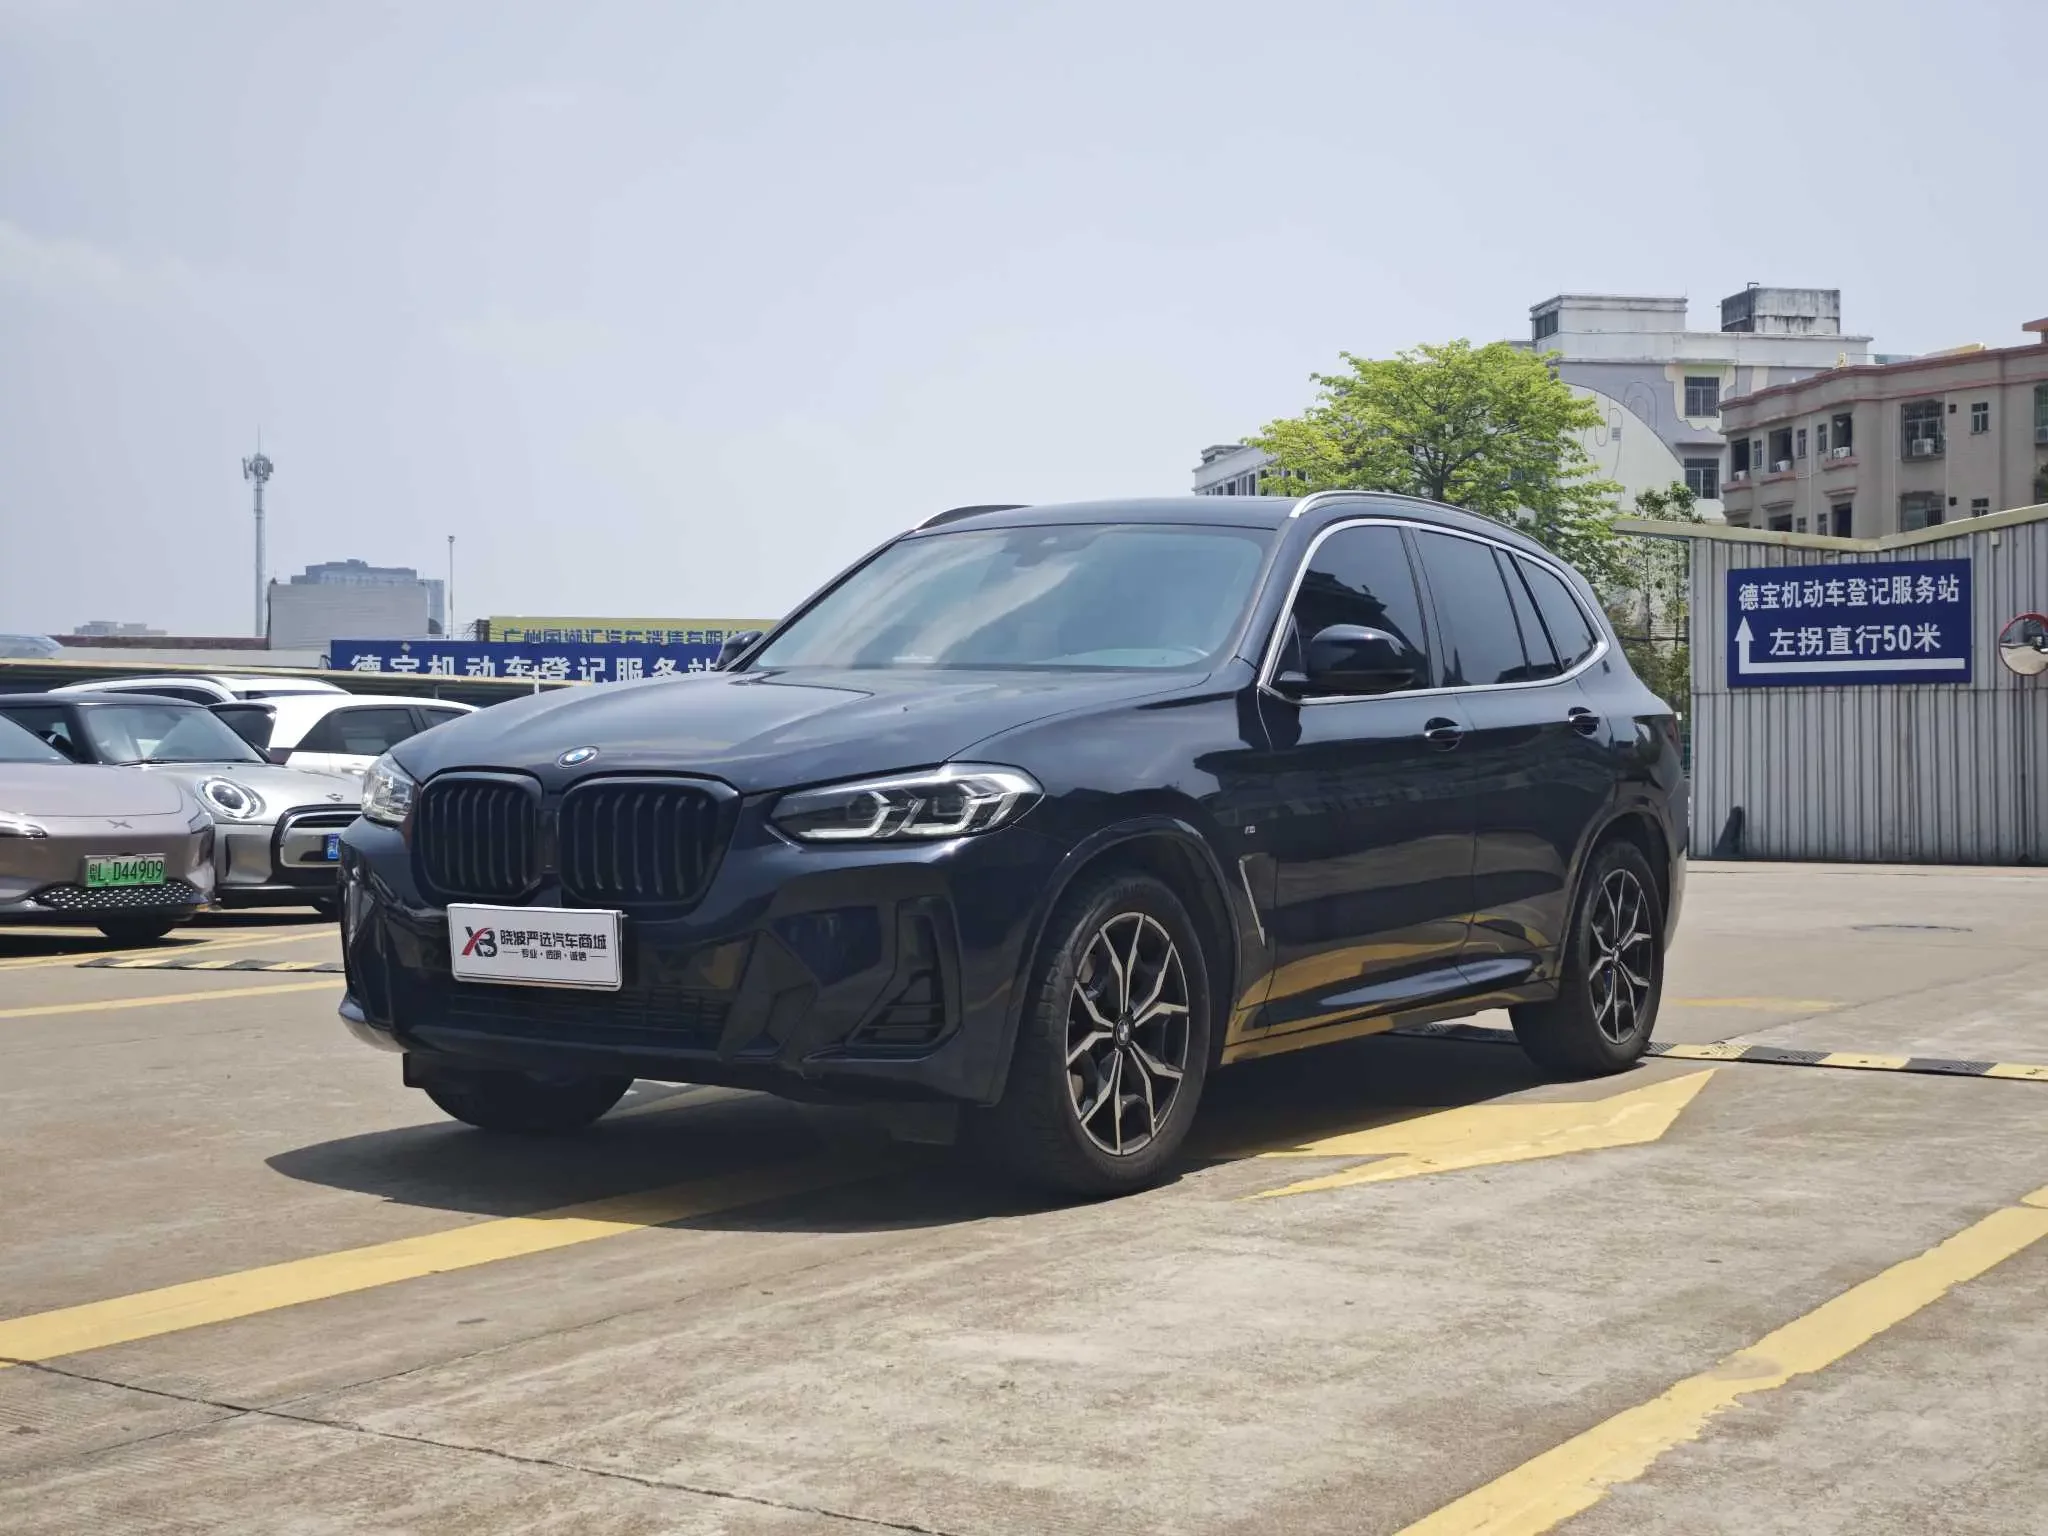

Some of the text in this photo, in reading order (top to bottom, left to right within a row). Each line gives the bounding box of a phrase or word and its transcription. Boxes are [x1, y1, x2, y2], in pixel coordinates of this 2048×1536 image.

[1739, 574, 1960, 611] 德宝机动车登记服务站
[1769, 622, 1942, 656] 左拐直行50米
